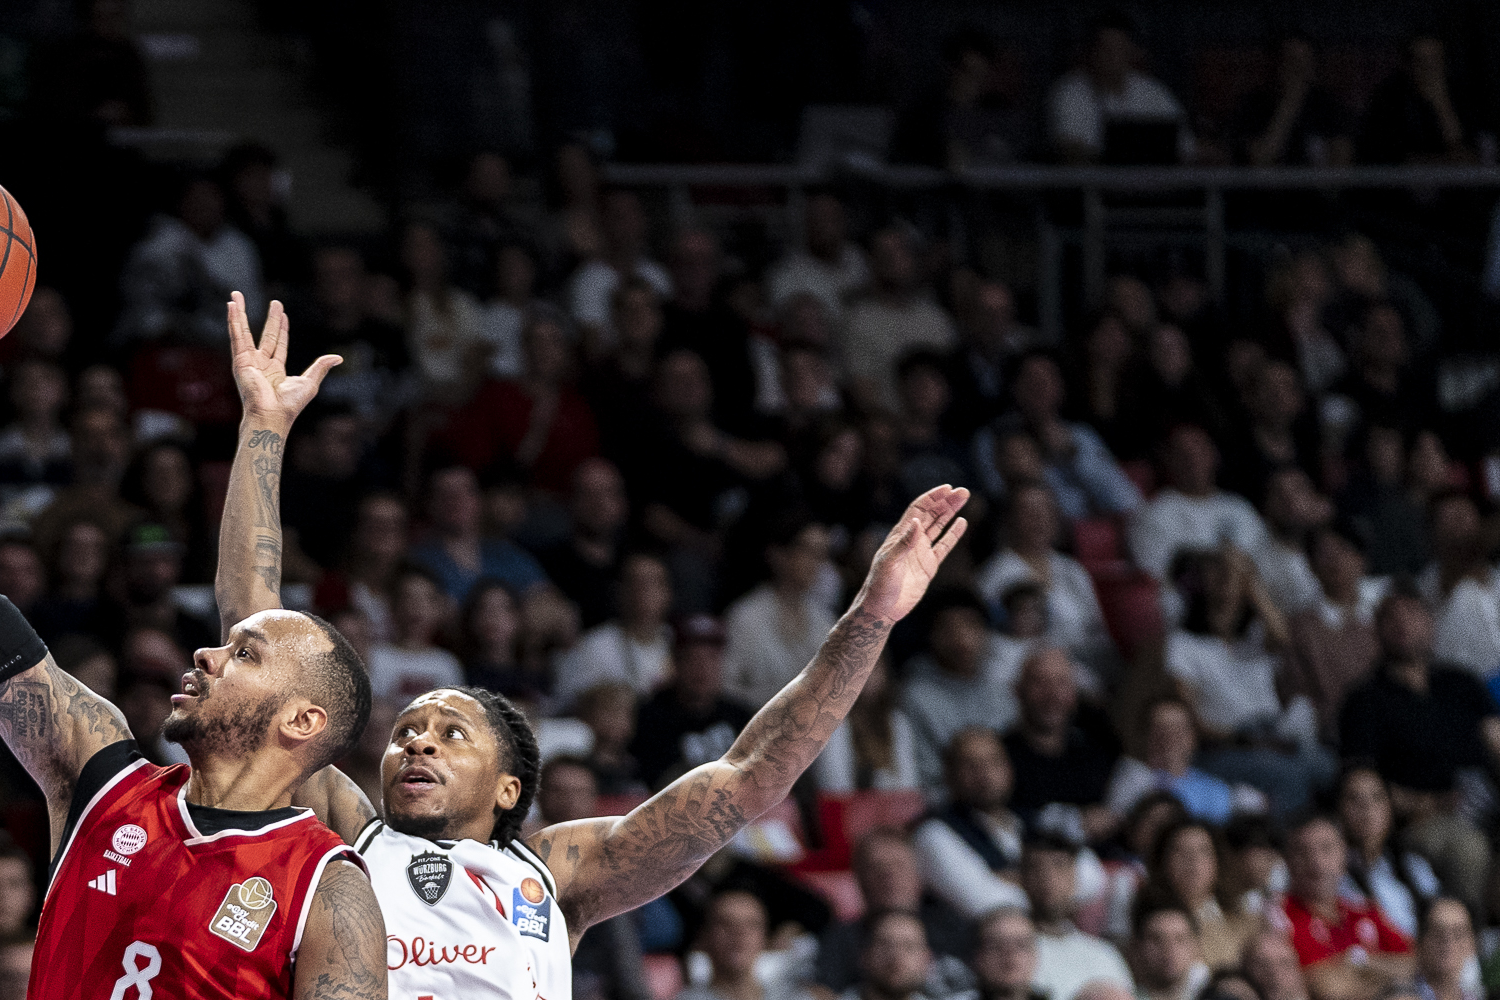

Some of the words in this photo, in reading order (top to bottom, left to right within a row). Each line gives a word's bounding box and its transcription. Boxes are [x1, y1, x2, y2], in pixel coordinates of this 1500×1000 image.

[413, 863, 447, 876] WÜRZBURG
[215, 915, 252, 944] BBL
[519, 918, 547, 938] BBL
[386, 935, 496, 970] Oliver
